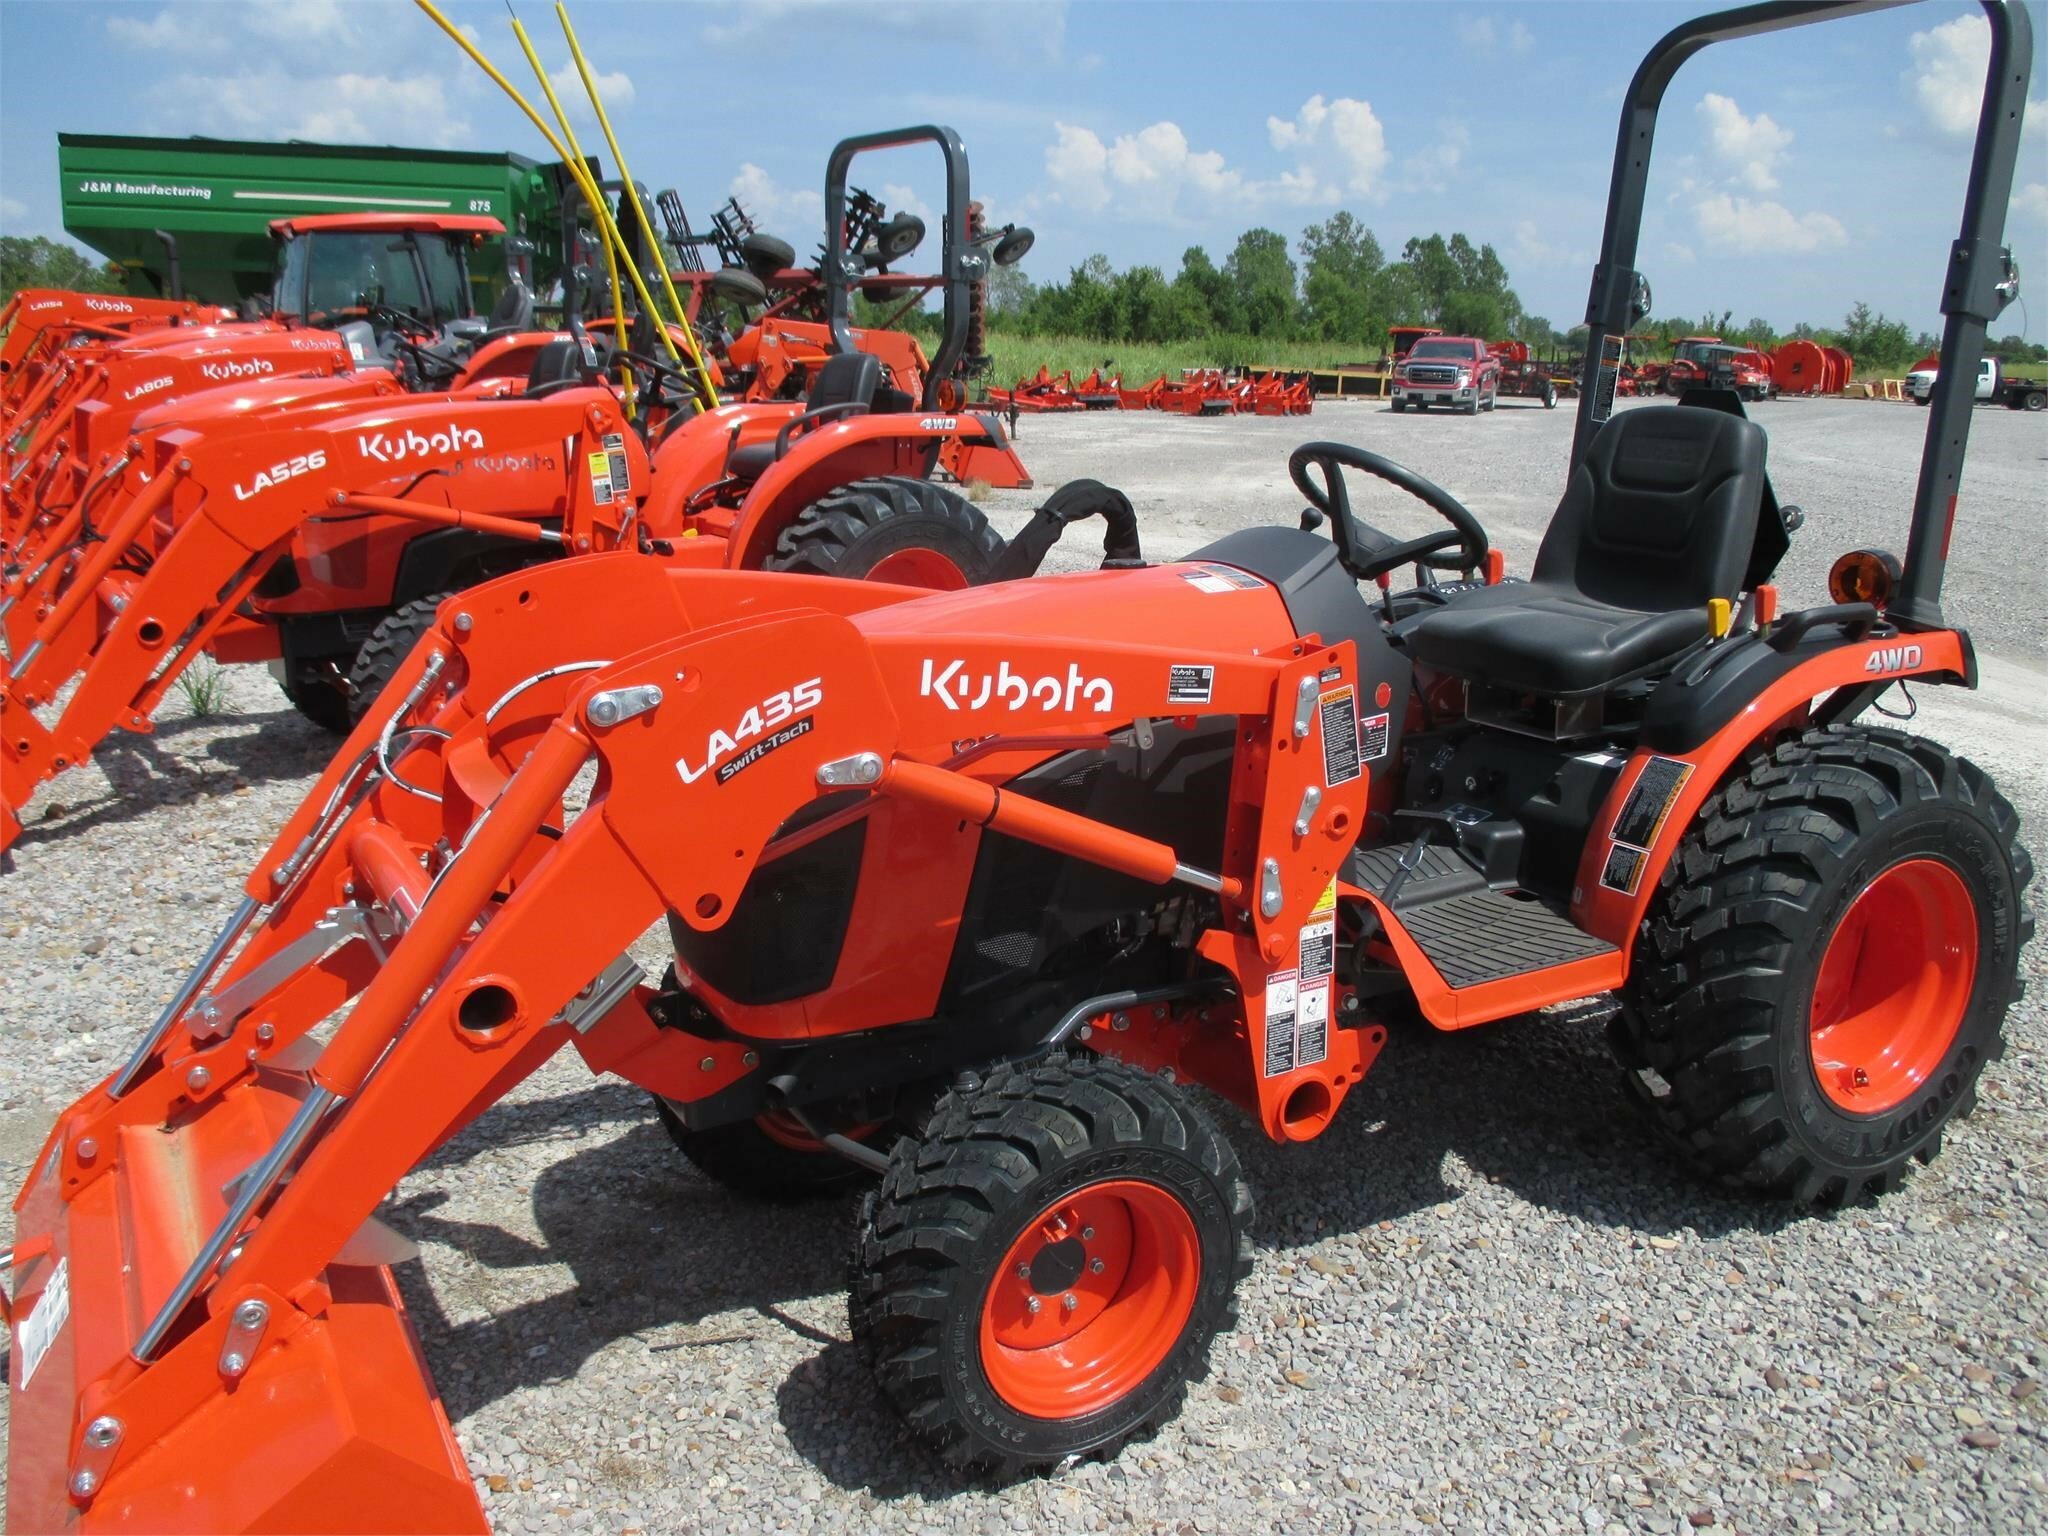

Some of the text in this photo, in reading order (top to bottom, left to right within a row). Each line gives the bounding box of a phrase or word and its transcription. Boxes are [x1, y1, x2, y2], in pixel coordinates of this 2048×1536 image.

[80, 181, 212, 199] J&M Manufacturing
[470, 200, 490, 212] 875
[86, 299, 133, 313] Kubota
[291, 339, 341, 349] Kubota
[203, 357, 274, 380] Kubota
[125, 376, 174, 400] LA805
[920, 419, 957, 430] 4WD
[358, 424, 484, 462] Kubota
[473, 452, 556, 473] Kubota
[233, 450, 327, 501] LA526
[1865, 645, 1921, 675] 4WD
[920, 659, 1113, 712] Kubota
[1326, 688, 1352, 701] WARNING
[675, 677, 823, 784] LA435
[721, 720, 810, 780] Swift-Tach
[1273, 972, 1297, 982] DANGER
[1304, 980, 1328, 991] DANGER
